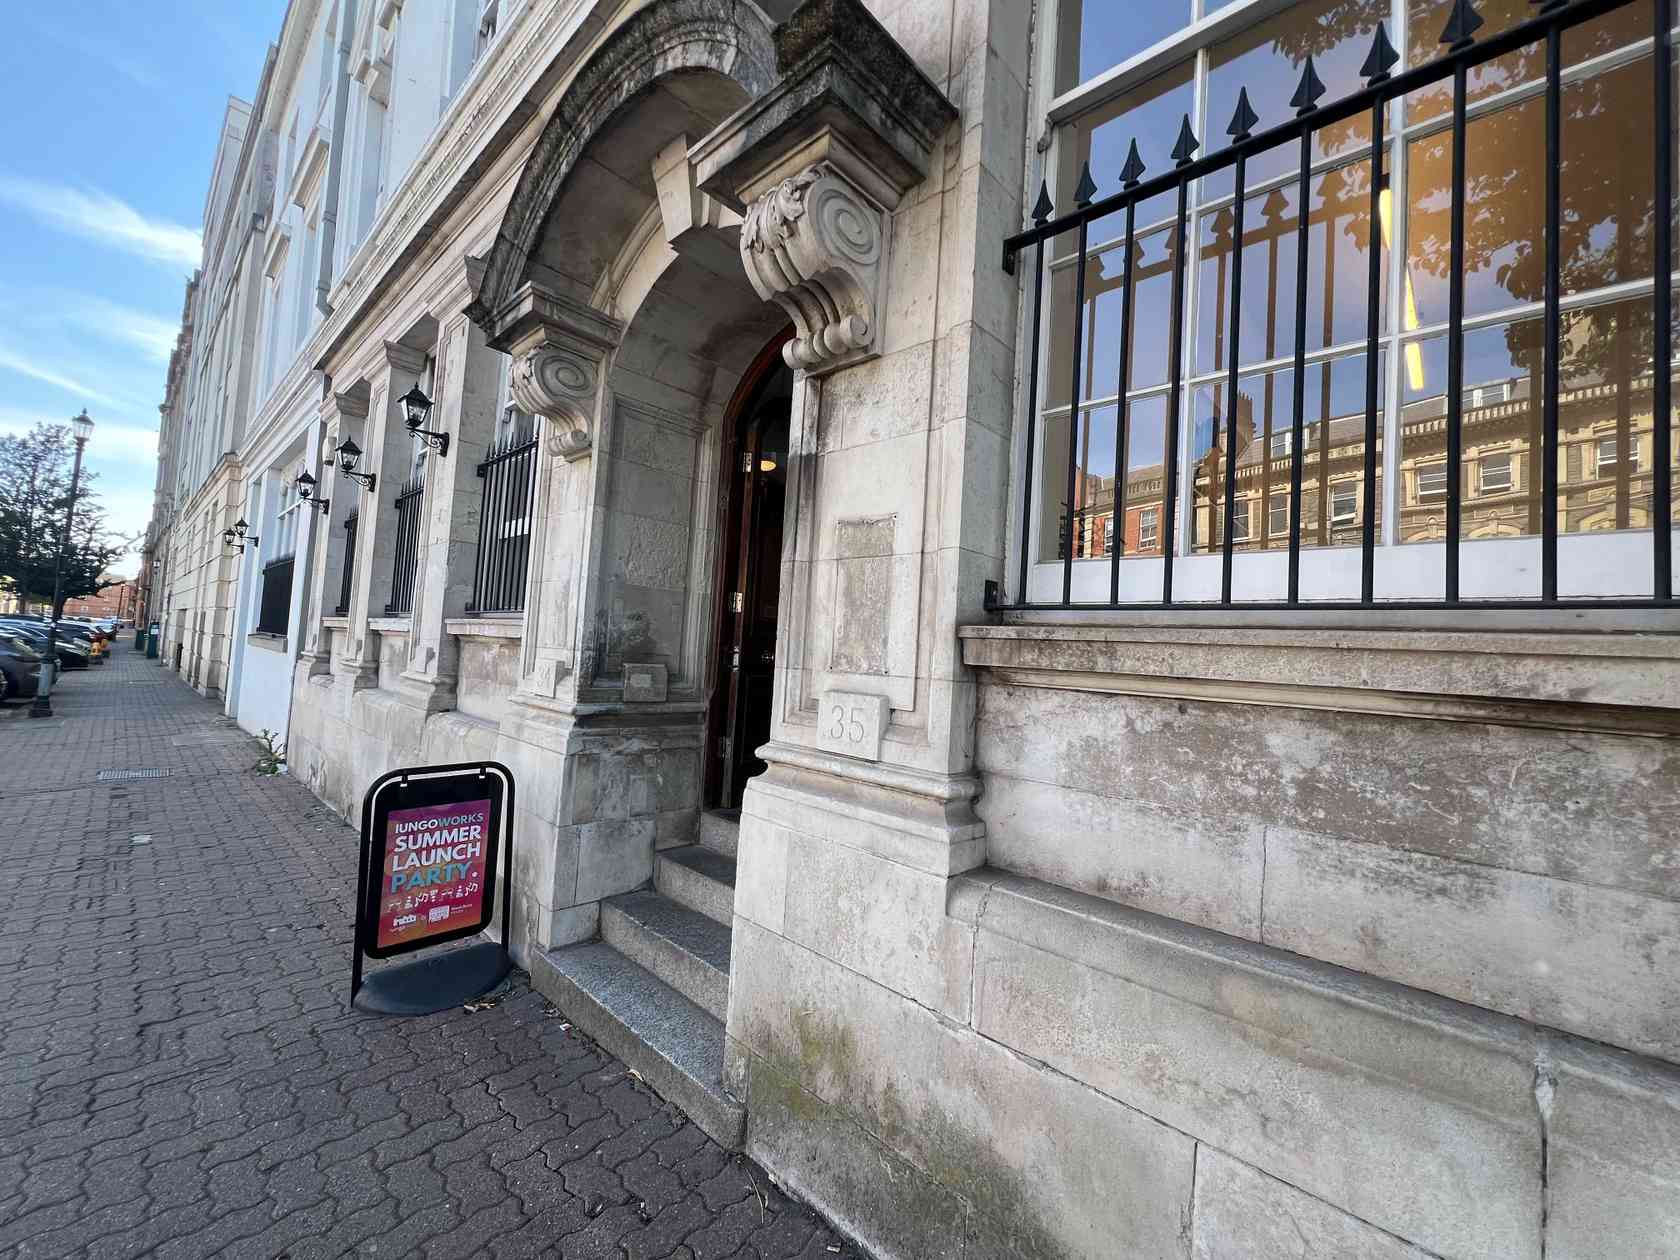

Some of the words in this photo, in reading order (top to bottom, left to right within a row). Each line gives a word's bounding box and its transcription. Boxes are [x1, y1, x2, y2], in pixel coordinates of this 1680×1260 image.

[831, 705, 864, 743] 35
[394, 825, 482, 852] SUMMER
[395, 813, 484, 834] IUNGOWORKS
[392, 842, 480, 872] LAUNCH
[391, 861, 472, 894] PARTY
